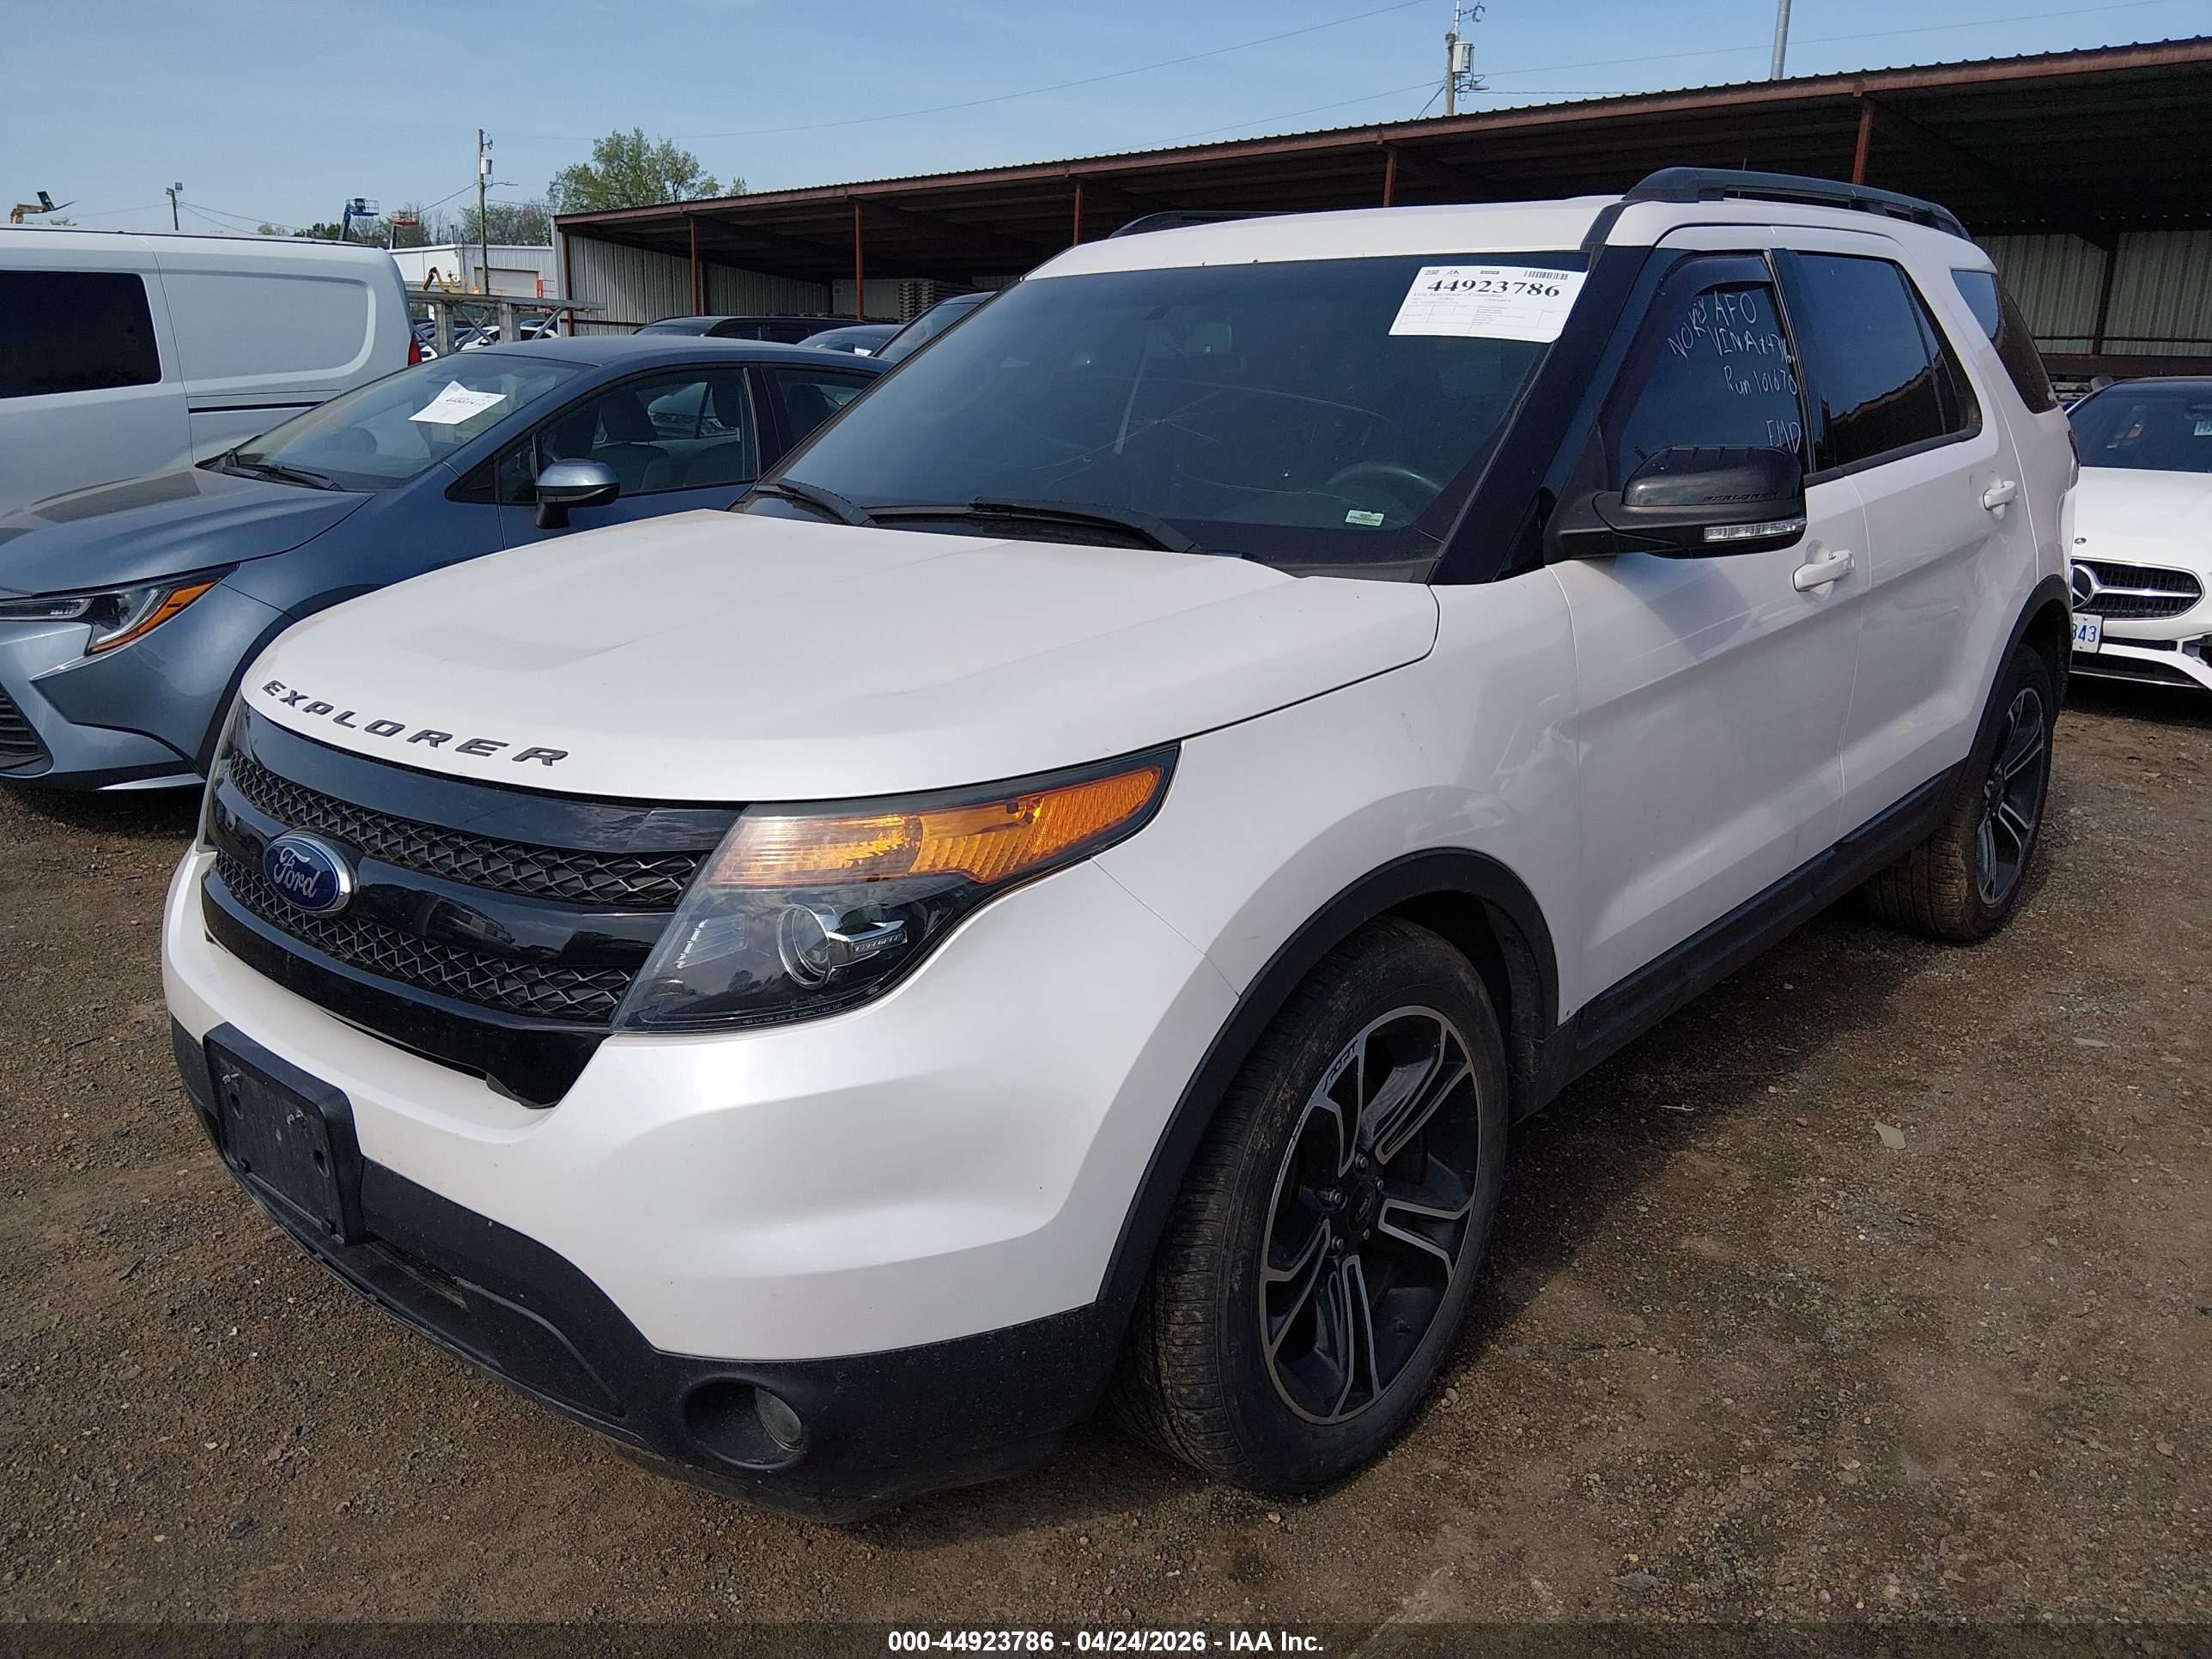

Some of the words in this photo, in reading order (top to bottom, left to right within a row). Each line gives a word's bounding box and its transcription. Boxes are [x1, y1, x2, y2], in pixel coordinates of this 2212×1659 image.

[1427, 278, 1562, 297] 44923786
[1714, 290, 1757, 326] AFO
[262, 679, 568, 766] EXPLORER
[273, 847, 321, 898] Ford
[1322, 1039, 1358, 1092] SPORT
